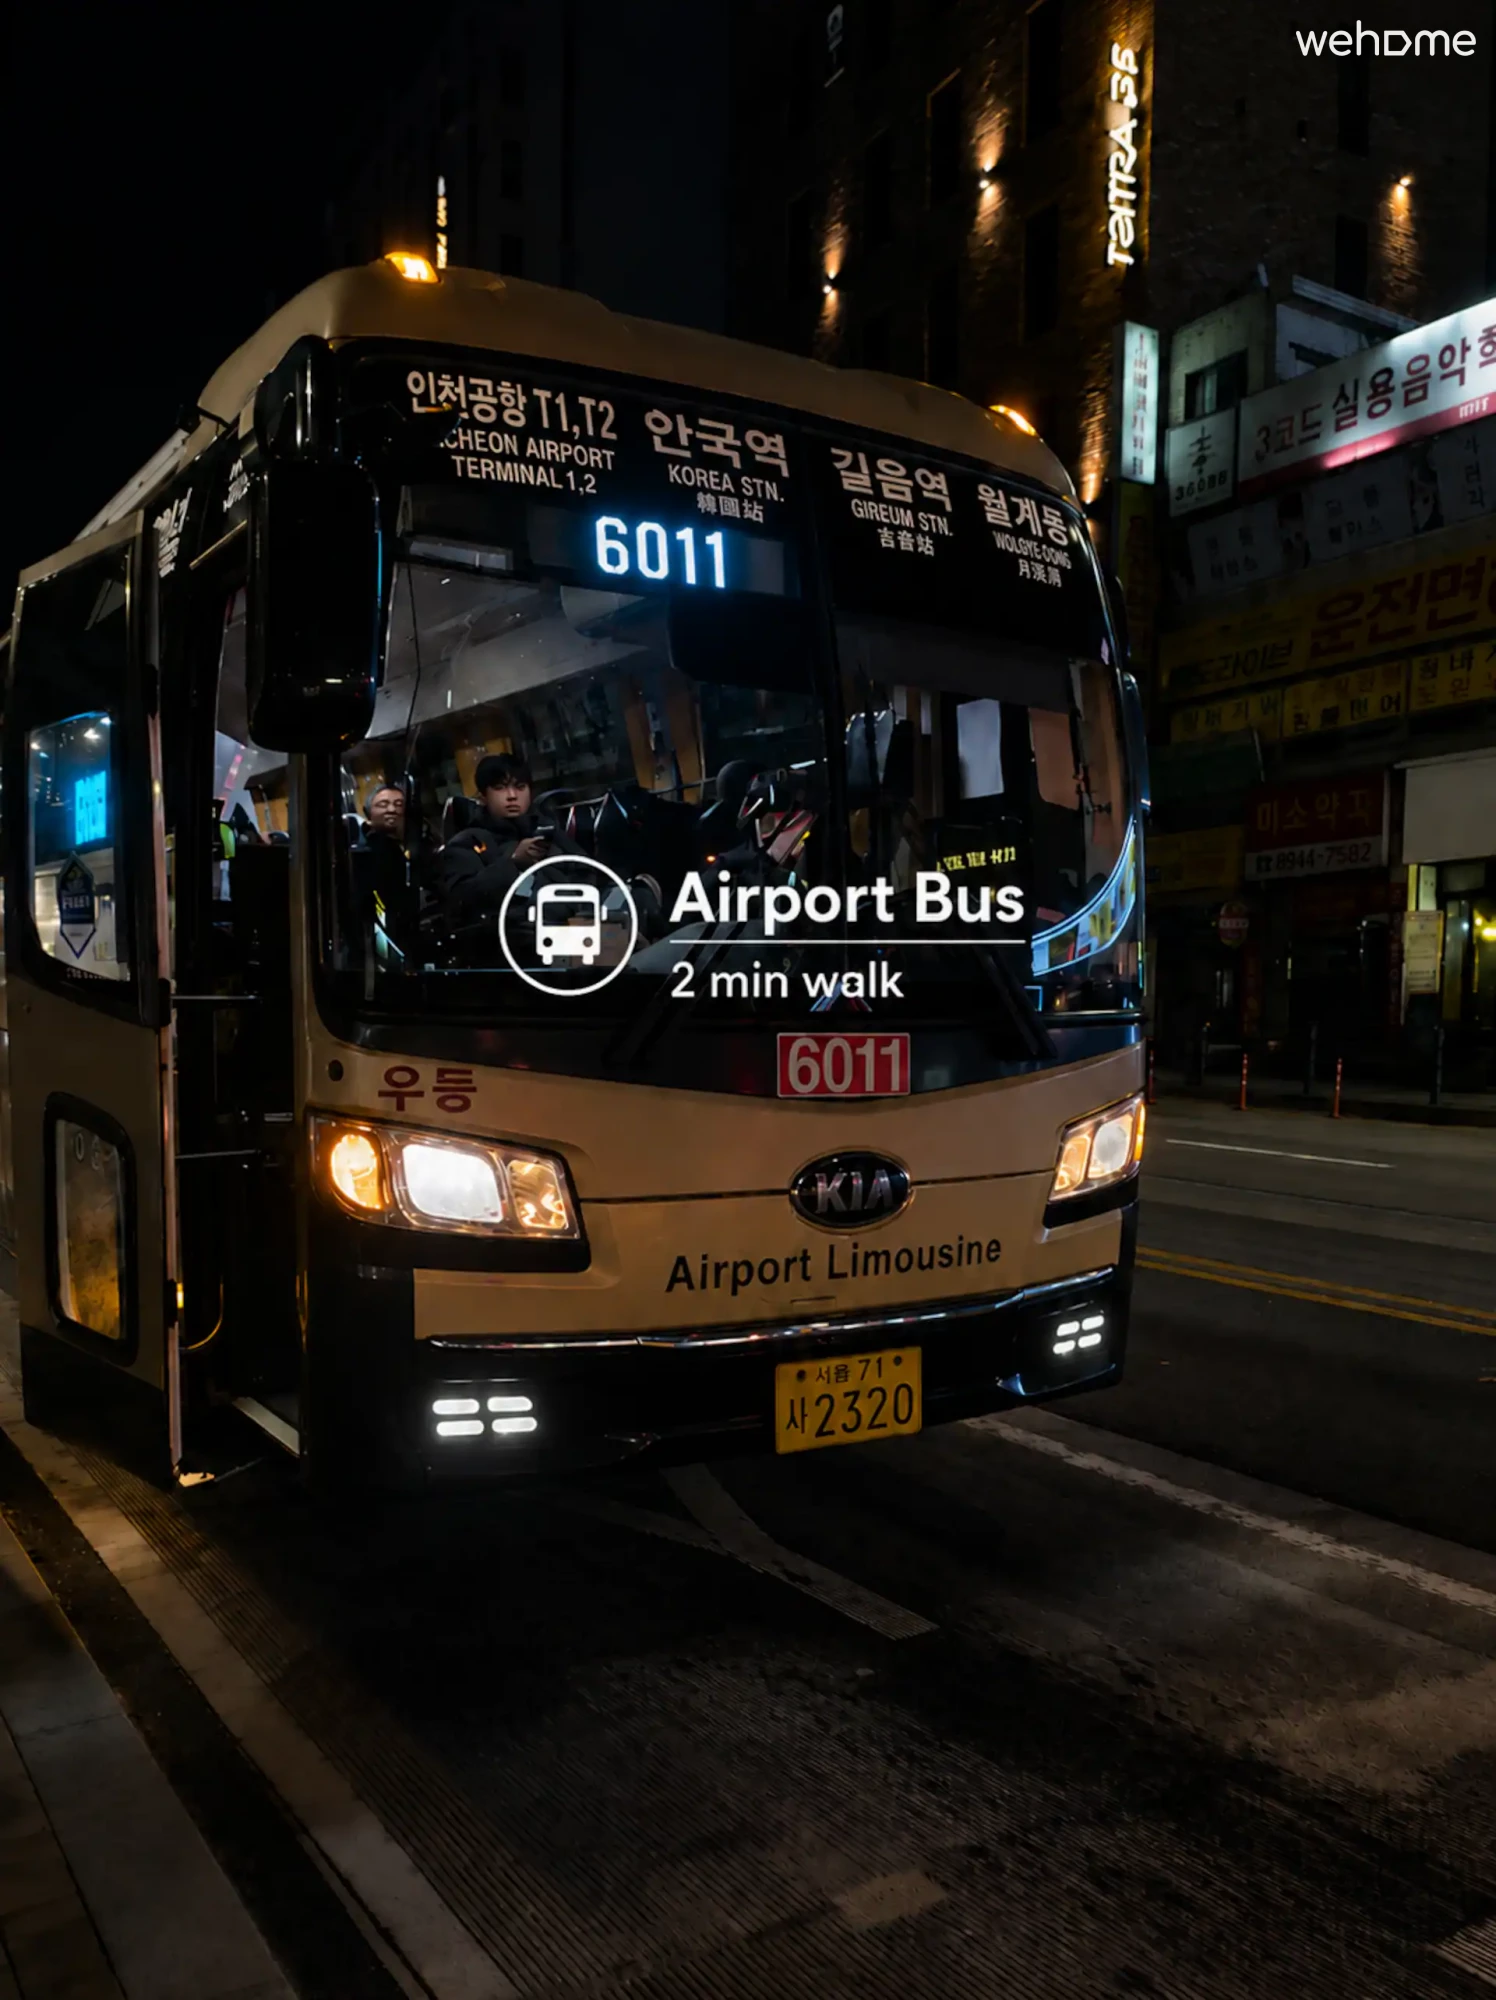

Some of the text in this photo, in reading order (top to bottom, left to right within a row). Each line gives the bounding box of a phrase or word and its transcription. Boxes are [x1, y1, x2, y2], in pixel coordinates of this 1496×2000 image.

[533, 387, 618, 441] T1,T2
[443, 428, 615, 471] CHEON AIRPORT
[645, 409, 790, 478] 안국역
[451, 456, 598, 495] TERMINAL 1,2
[668, 464, 785, 503] KOREA STN.
[831, 447, 953, 512] 길음역
[851, 499, 953, 537] GIREUM STN.
[977, 483, 1069, 547] 월계동
[595, 515, 726, 589] 6011
[1310, 554, 1496, 660] 운전면
[378, 1065, 478, 1113] 우등
[786, 1036, 904, 1095] 6011
[814, 1168, 895, 1214] KIA
[665, 1235, 1003, 1296] Airport Limousine
[858, 1357, 884, 1381] 71
